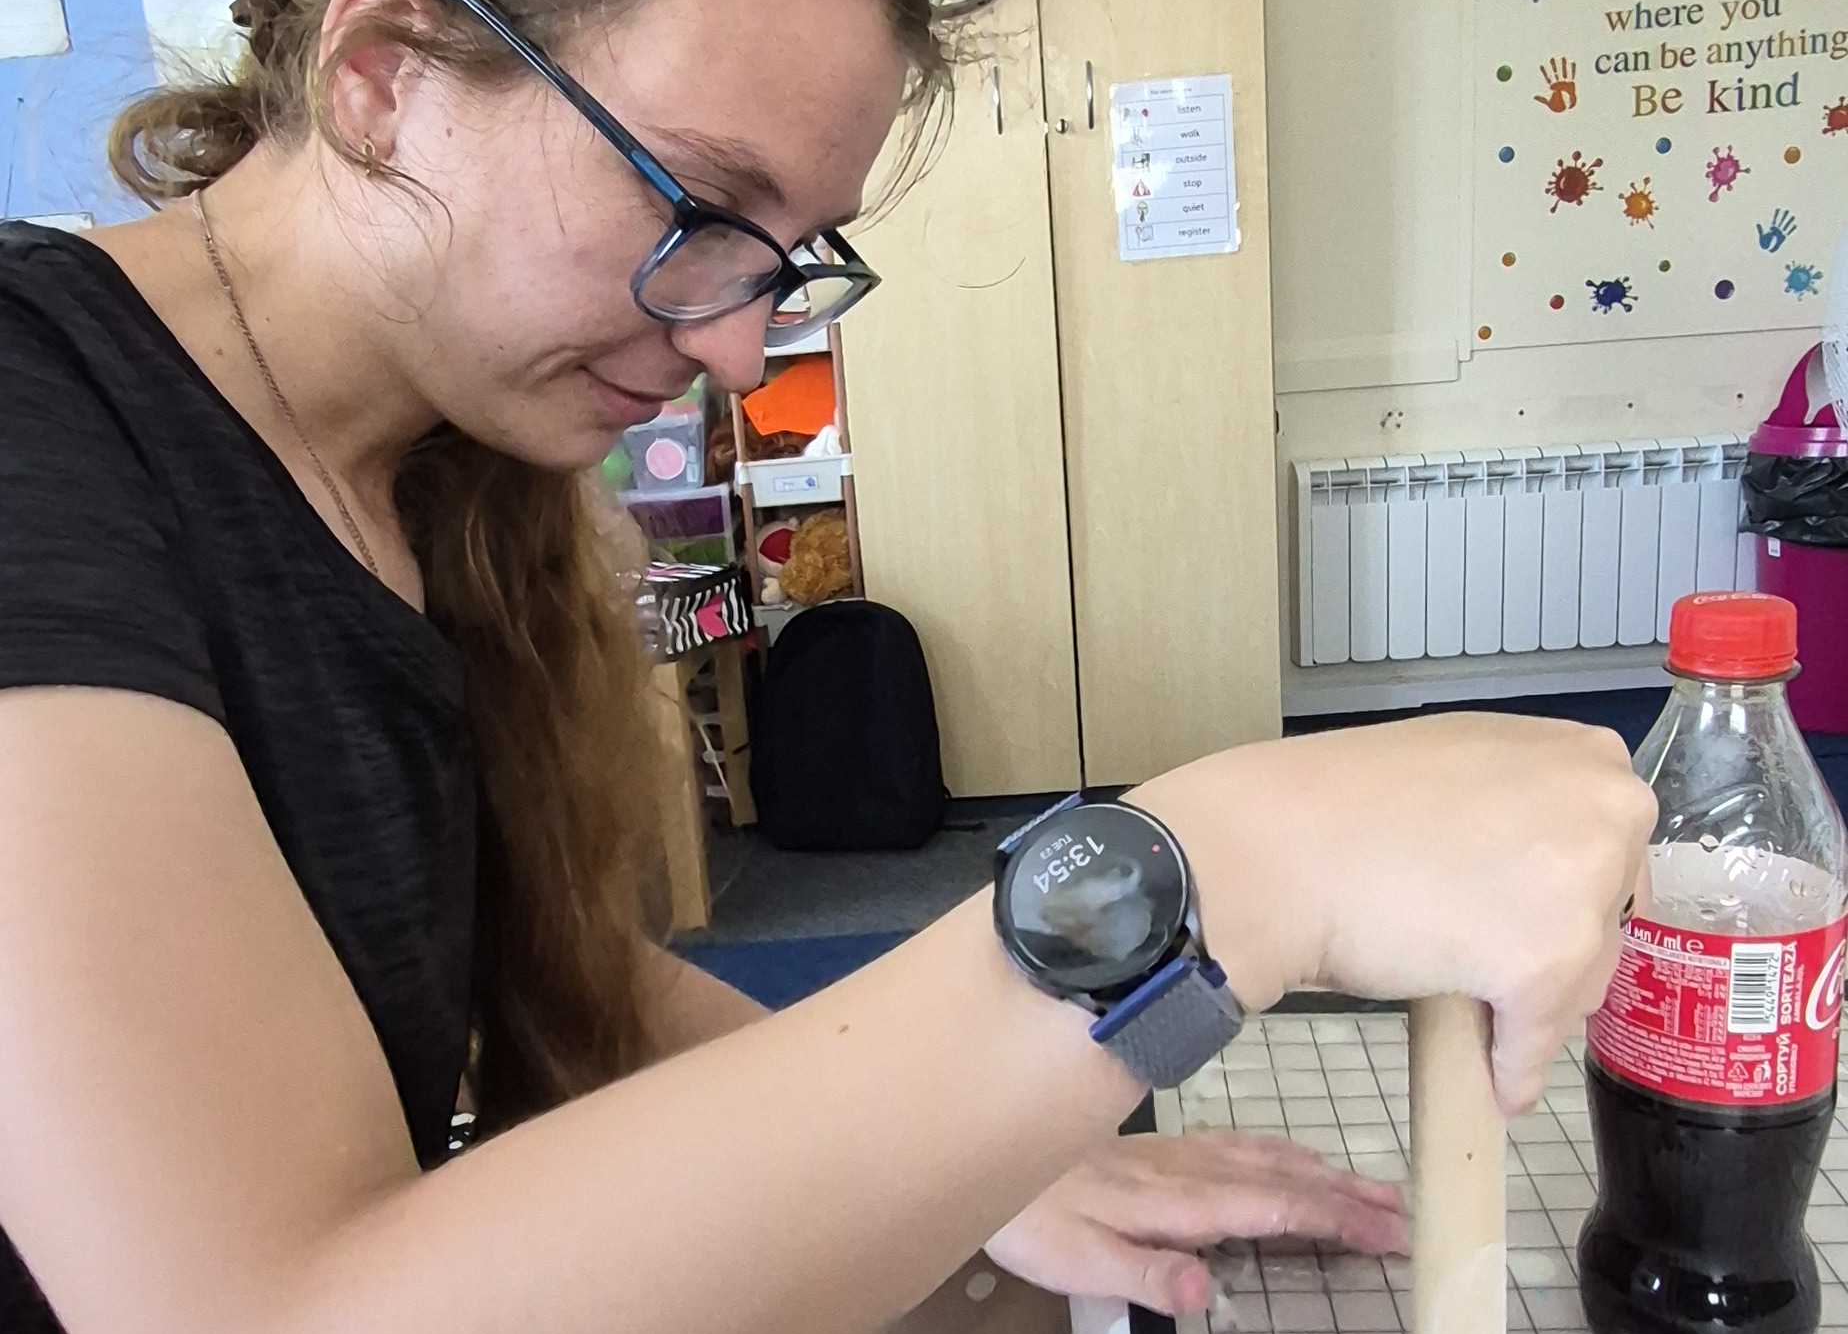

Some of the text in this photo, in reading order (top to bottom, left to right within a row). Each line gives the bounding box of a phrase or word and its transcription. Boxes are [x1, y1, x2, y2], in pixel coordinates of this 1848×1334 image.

[1605, 1, 1704, 32] where
[1594, 29, 1848, 75] can be anything
[1632, 71, 1802, 118] Be kind
[1177, 104, 1201, 115] listen
[1180, 128, 1200, 139] walk
[1175, 152, 1207, 164] outside
[1183, 178, 1202, 189] stop
[1182, 202, 1204, 213] quiet
[1178, 226, 1211, 237] register
[1031, 835, 1106, 895] 13:54
